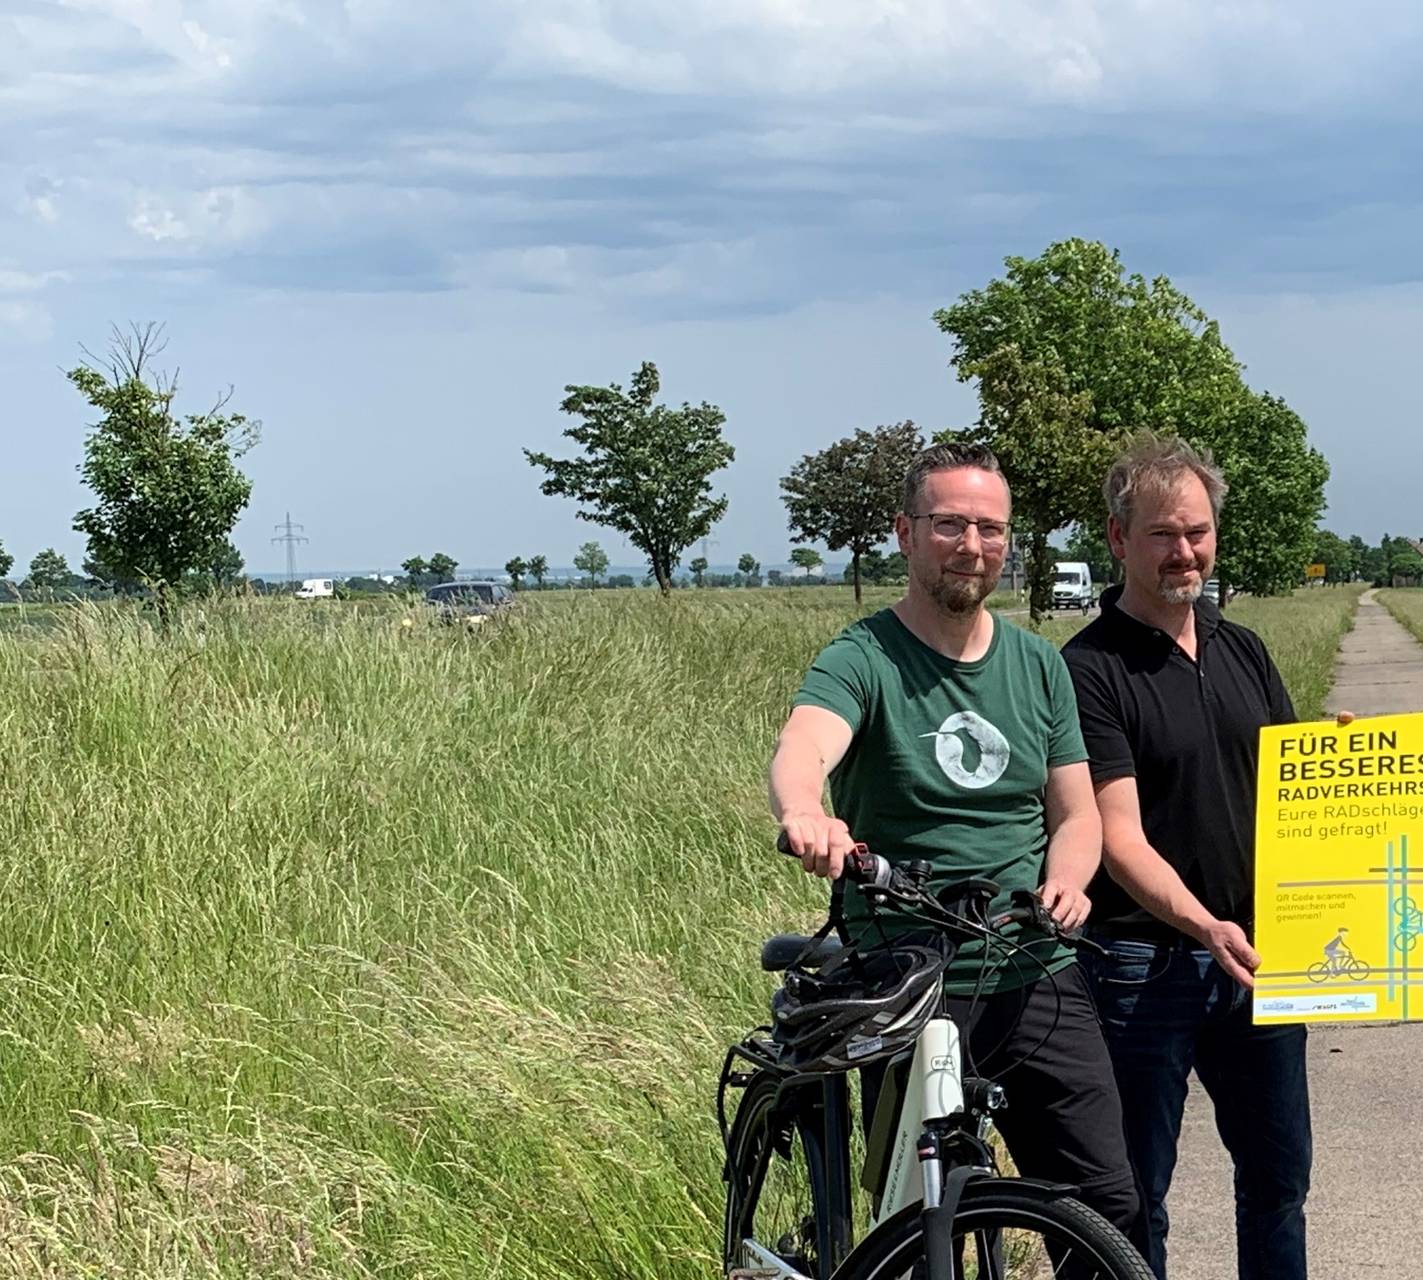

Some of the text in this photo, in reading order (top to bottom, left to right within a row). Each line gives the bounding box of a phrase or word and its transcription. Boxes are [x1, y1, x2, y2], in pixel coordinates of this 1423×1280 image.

[1280, 730, 1396, 758] FÜR EIN
[1278, 808, 1317, 821] Eure
[1277, 821, 1387, 841] sind gefragt!
